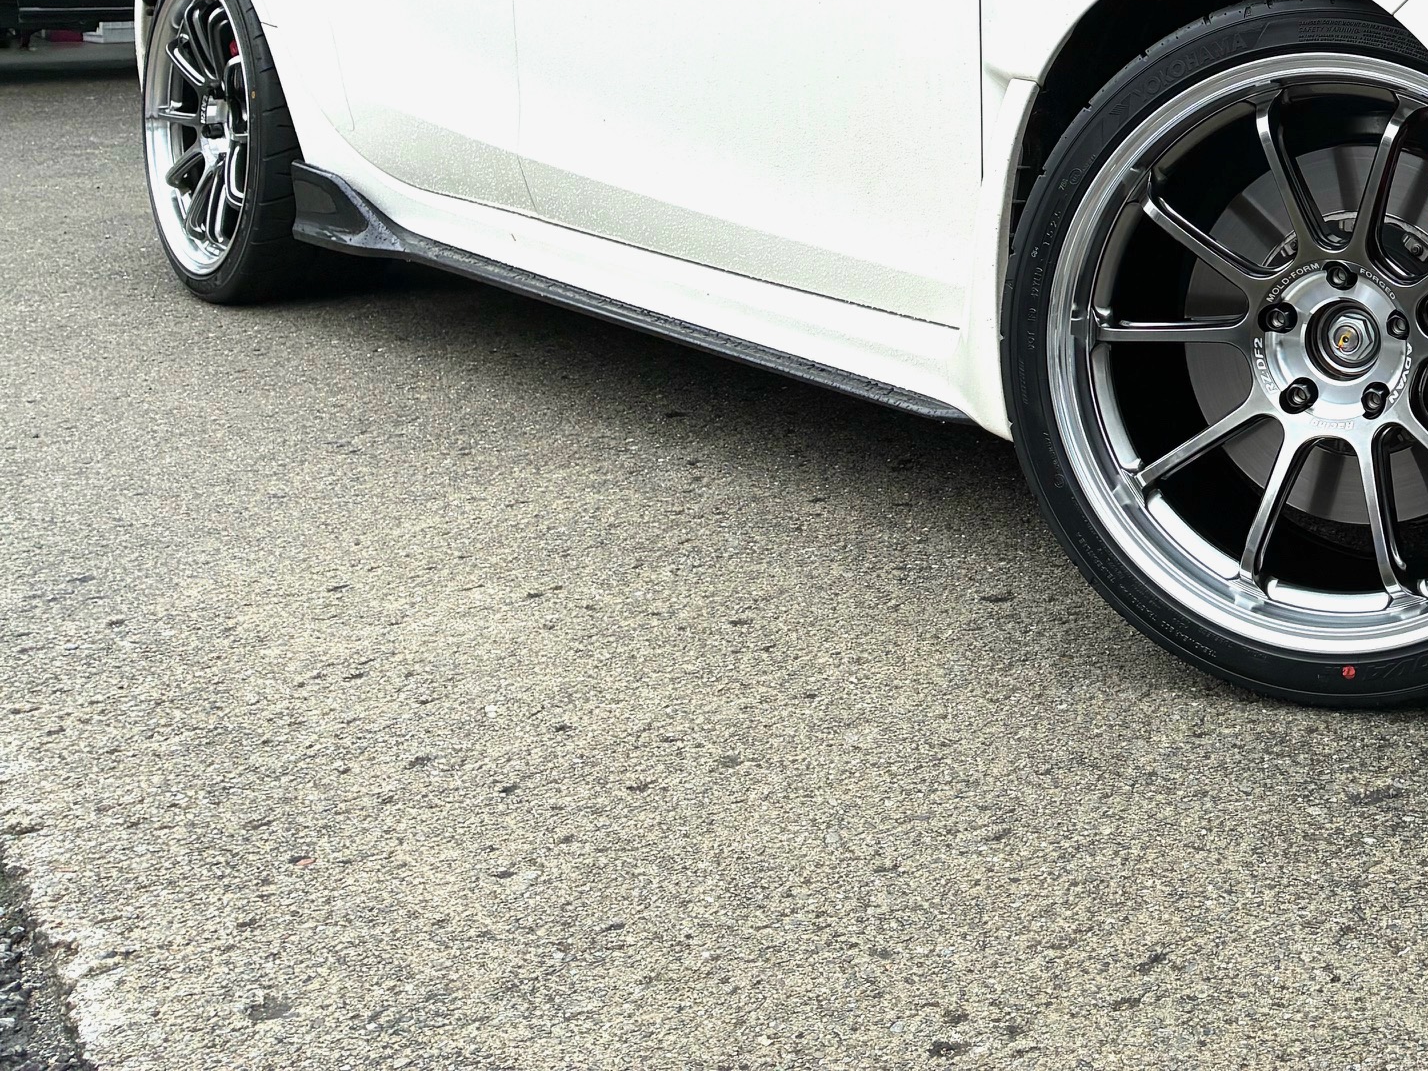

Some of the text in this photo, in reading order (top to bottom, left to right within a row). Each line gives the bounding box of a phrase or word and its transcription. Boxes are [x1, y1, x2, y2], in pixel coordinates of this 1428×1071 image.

[1133, 32, 1248, 102] YOKOHAMA
[1359, 267, 1397, 300] FORGED
[1388, 341, 1414, 404] ADVAN
[1309, 418, 1355, 431] Racing
